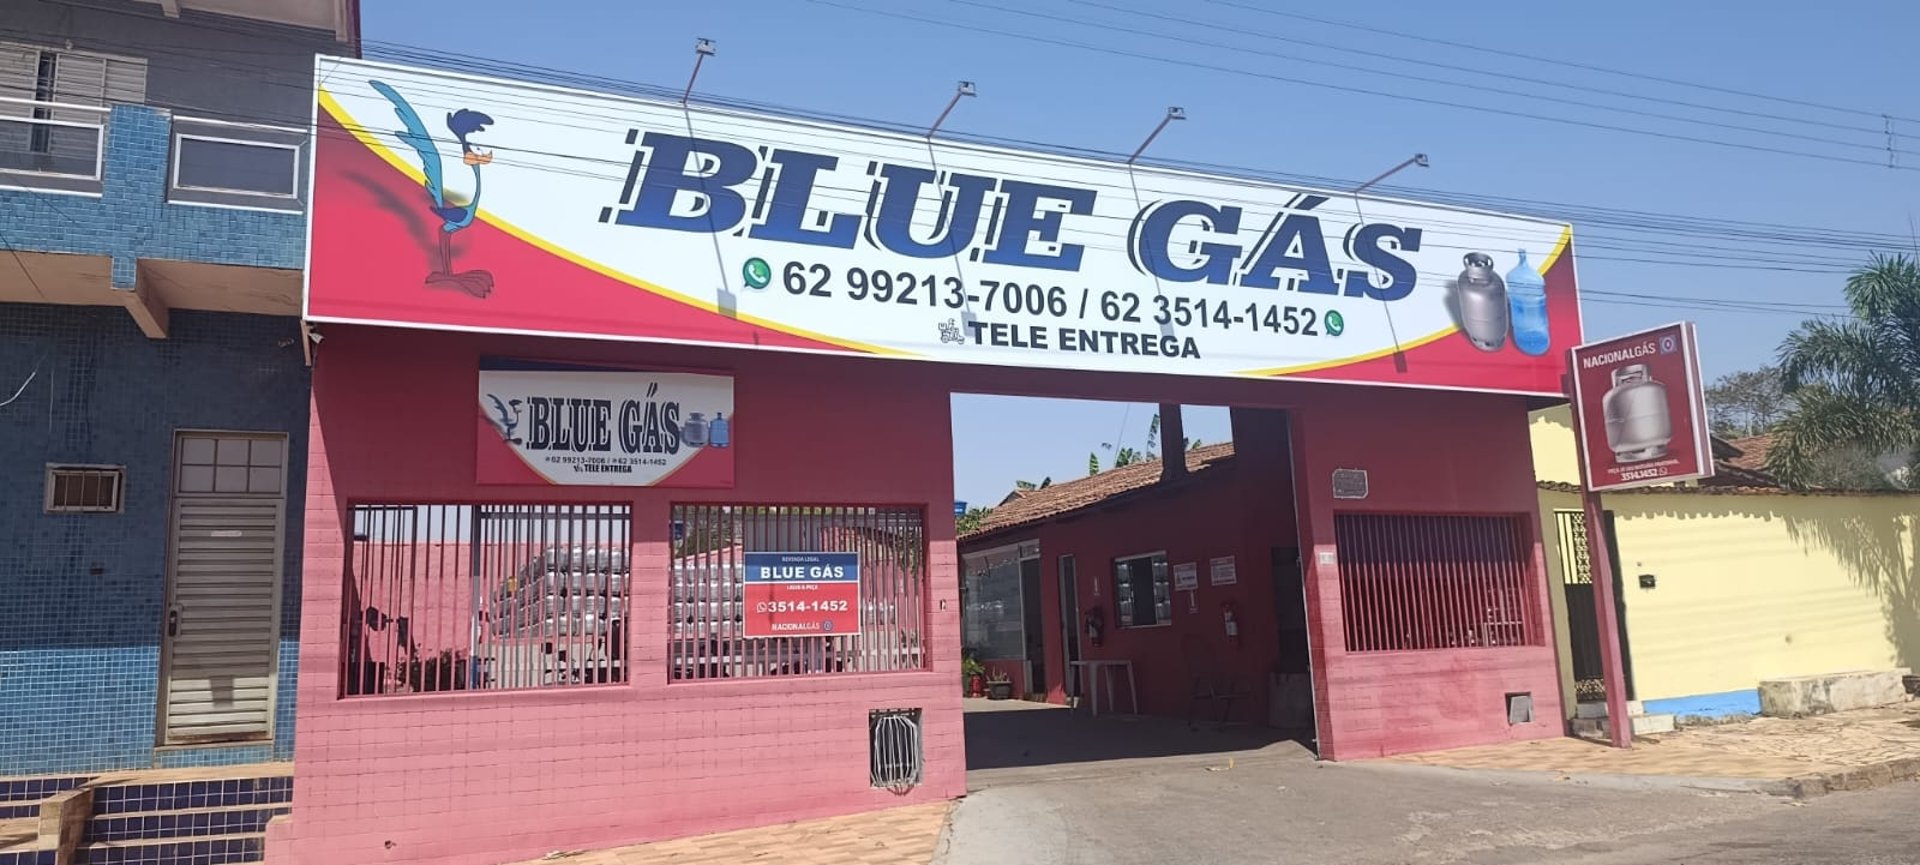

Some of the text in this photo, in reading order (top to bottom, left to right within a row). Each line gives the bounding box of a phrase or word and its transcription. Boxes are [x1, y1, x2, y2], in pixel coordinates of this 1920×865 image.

[600, 129, 1423, 301] BLUE GÁS
[783, 261, 1319, 337] 62 99213-7006 / 62 3514-1452
[968, 321, 1201, 360] TELE ENTREGA
[1583, 341, 1657, 369] NACIONALGÁS
[527, 382, 681, 455] BLUE GÁS
[585, 464, 632, 474] TELE ENTREGA
[760, 564, 844, 579] BLUE GÁS
[768, 600, 848, 613] 3514-1452
